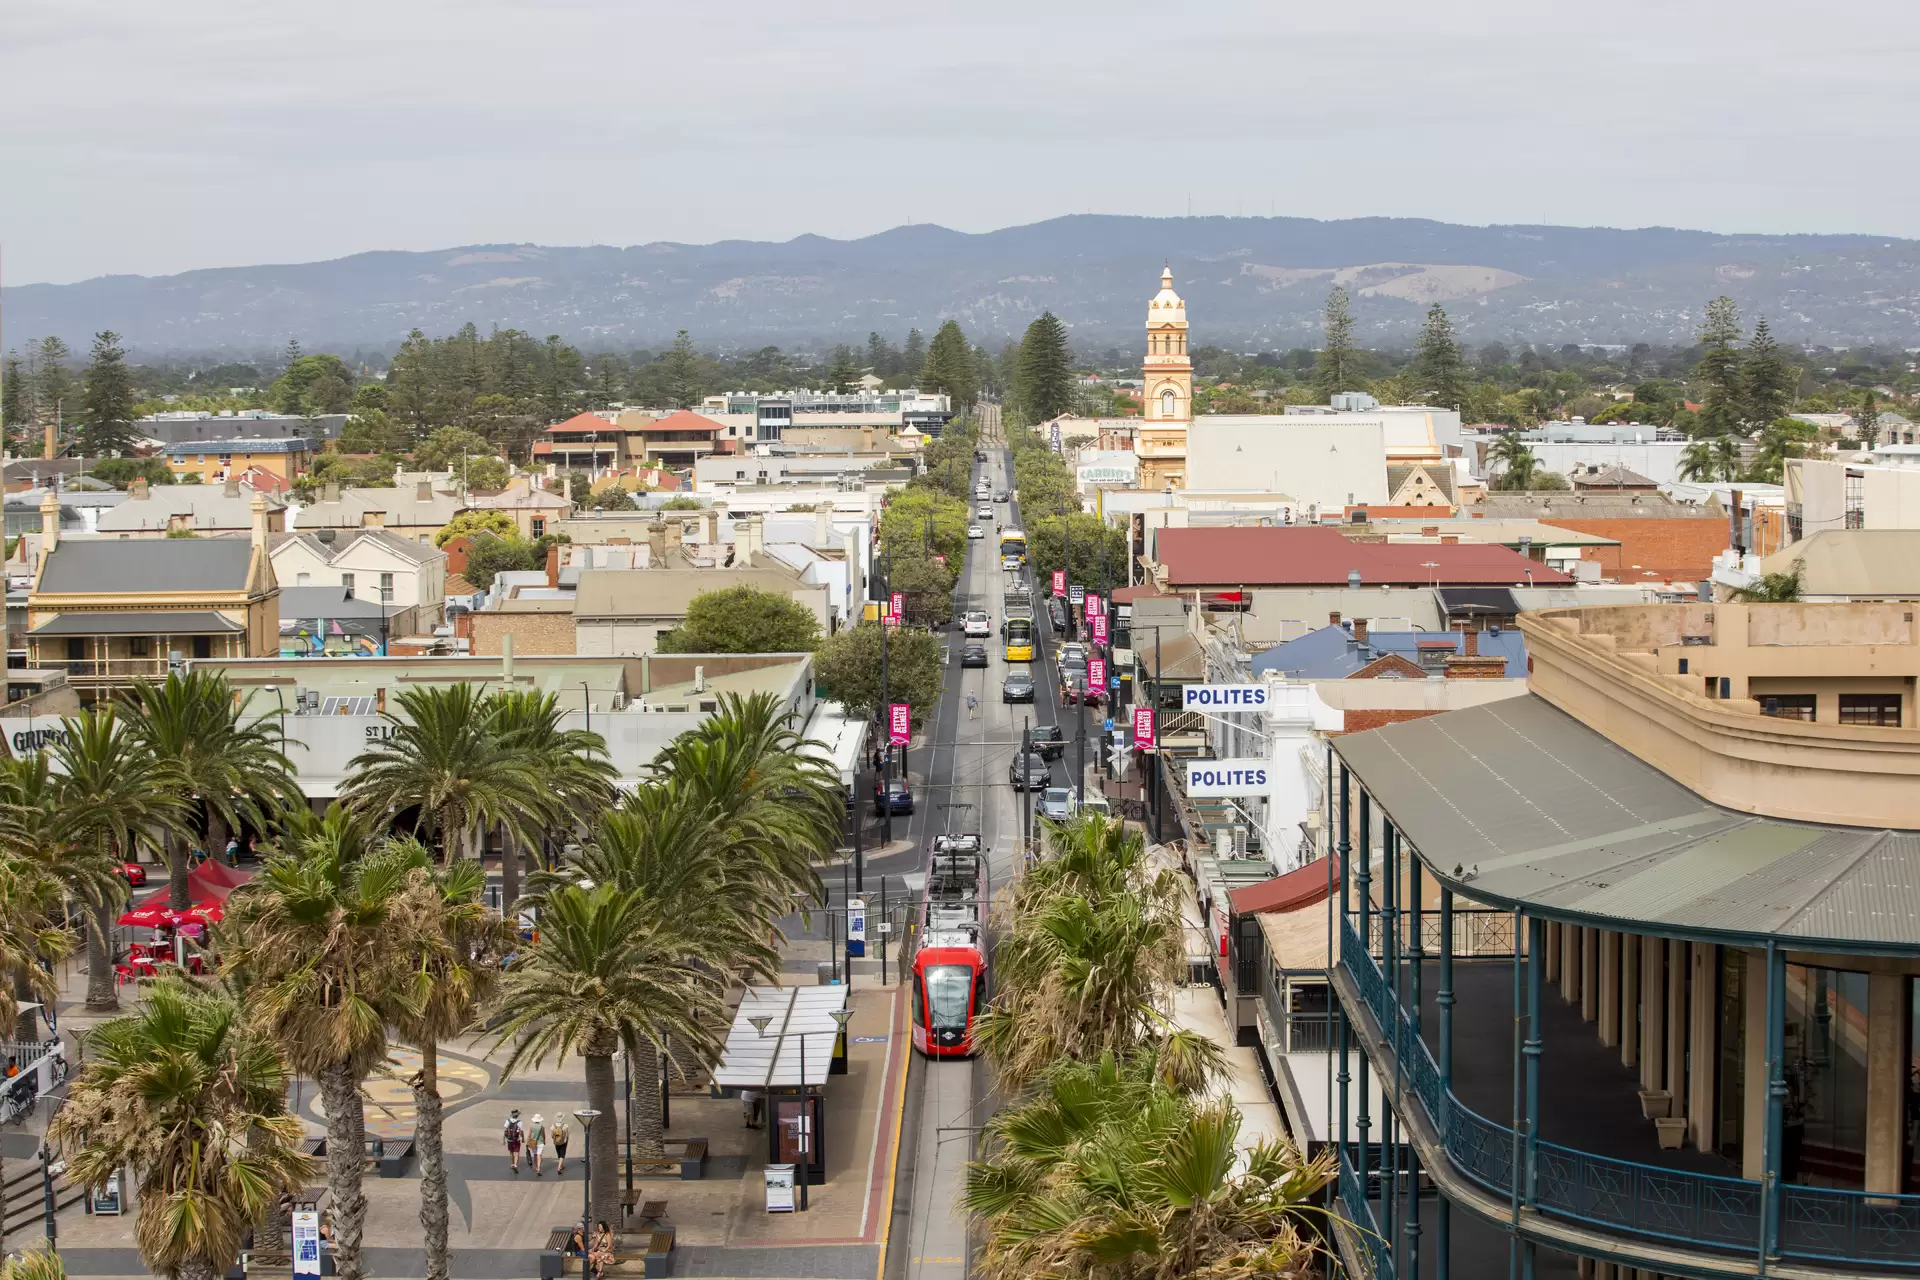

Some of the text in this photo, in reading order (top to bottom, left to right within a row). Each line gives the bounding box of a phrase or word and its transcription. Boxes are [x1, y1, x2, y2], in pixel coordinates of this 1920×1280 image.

[1187, 689, 1265, 704] POLITES
[365, 726, 379, 737] ST
[1191, 770, 1267, 786] POLITES
